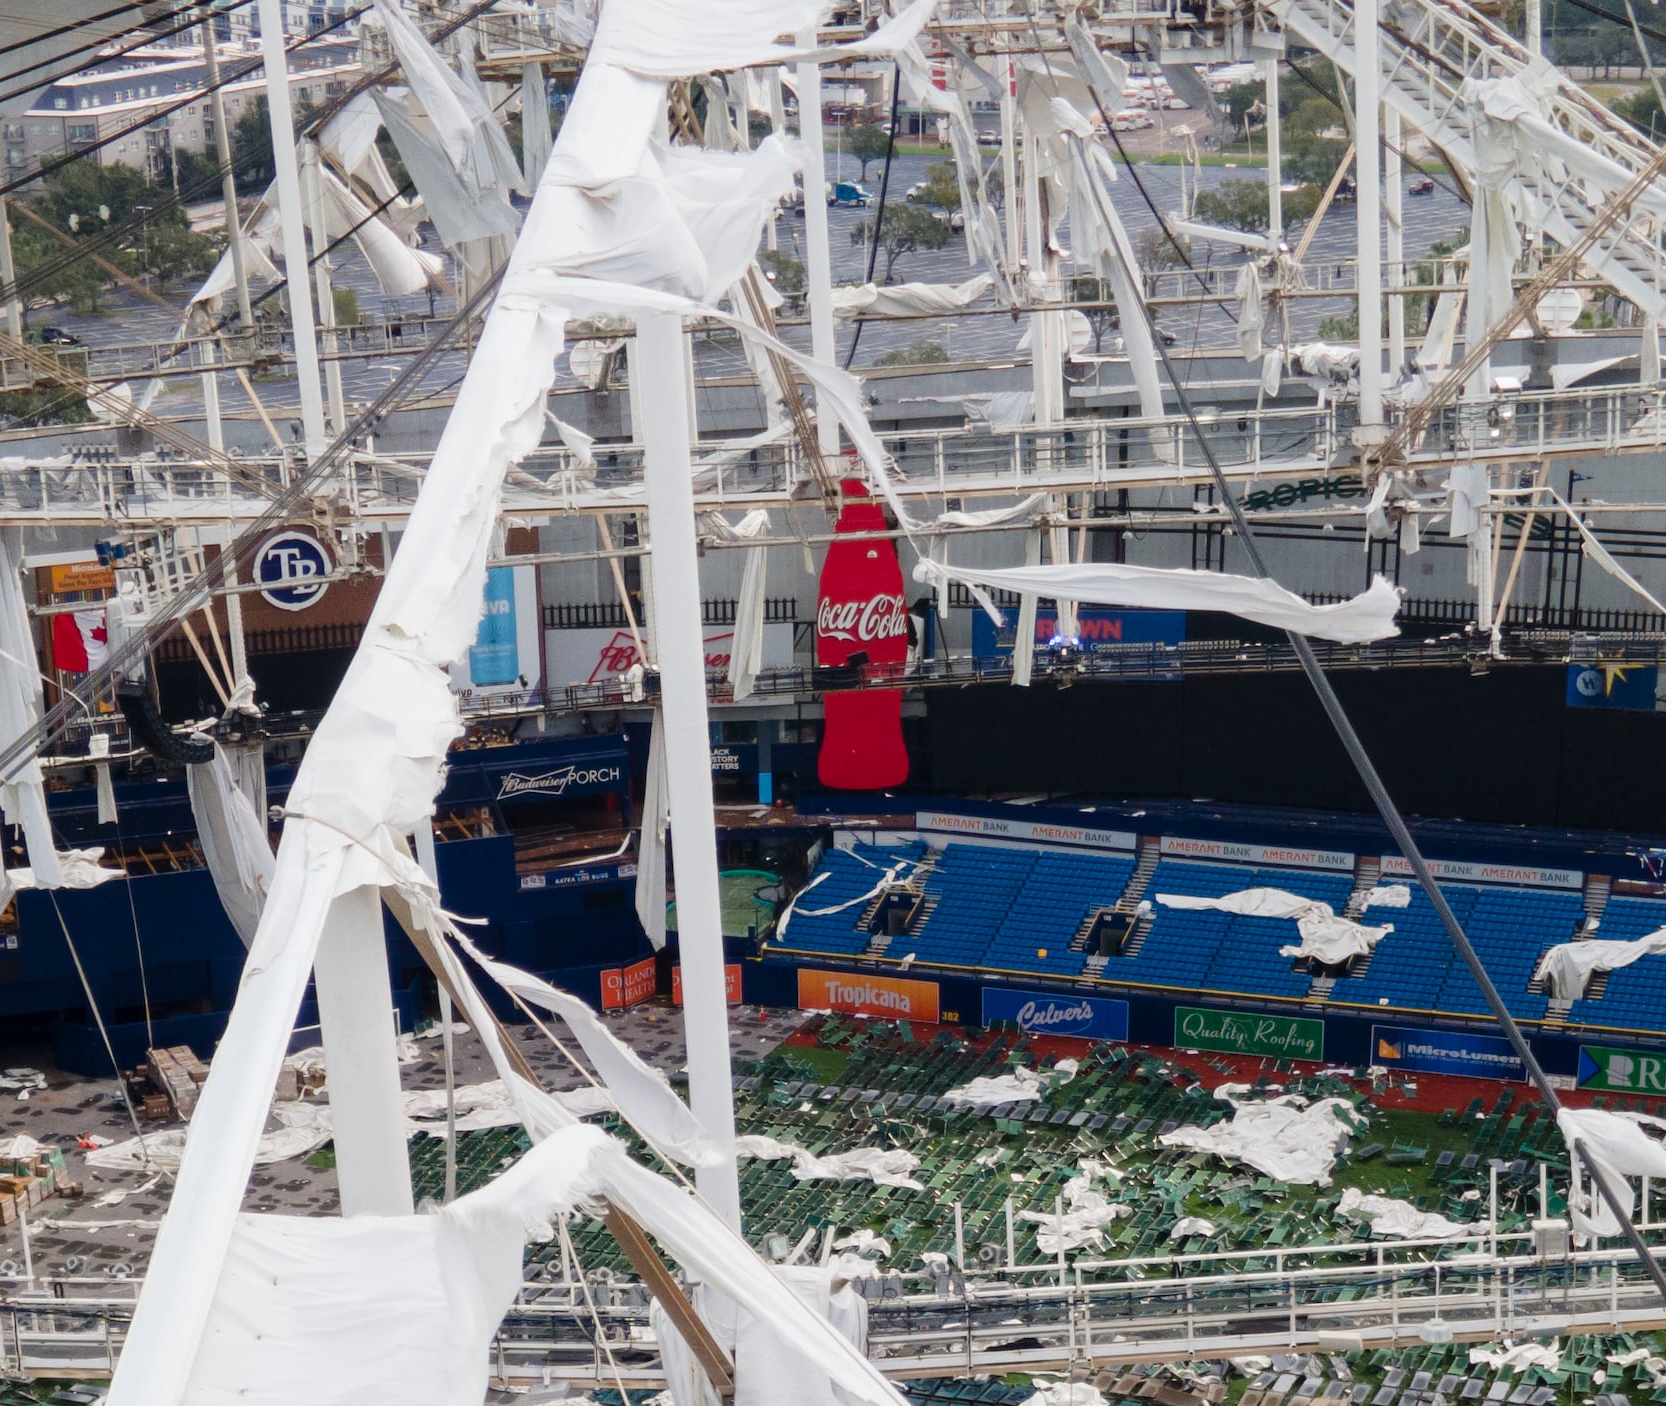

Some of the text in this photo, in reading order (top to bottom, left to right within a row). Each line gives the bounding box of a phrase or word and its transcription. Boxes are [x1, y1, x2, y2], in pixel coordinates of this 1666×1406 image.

[817, 594, 907, 641] Coca-Cola
[568, 766, 620, 785] PORCH
[931, 816, 1112, 844] AMERANT BANK AMERANT BANK
[1167, 840, 1347, 866] AMERANT BANK AMERANT BANK
[1386, 859, 1570, 883] AMENT BANK AMERANT BANK
[824, 981, 911, 1013] Tropicana
[941, 1010, 960, 1022] 382
[1016, 1001, 1094, 1029] Culver's
[1183, 1012, 1315, 1053] Quality Roofing
[1407, 1043, 1522, 1065] MicroLumen
